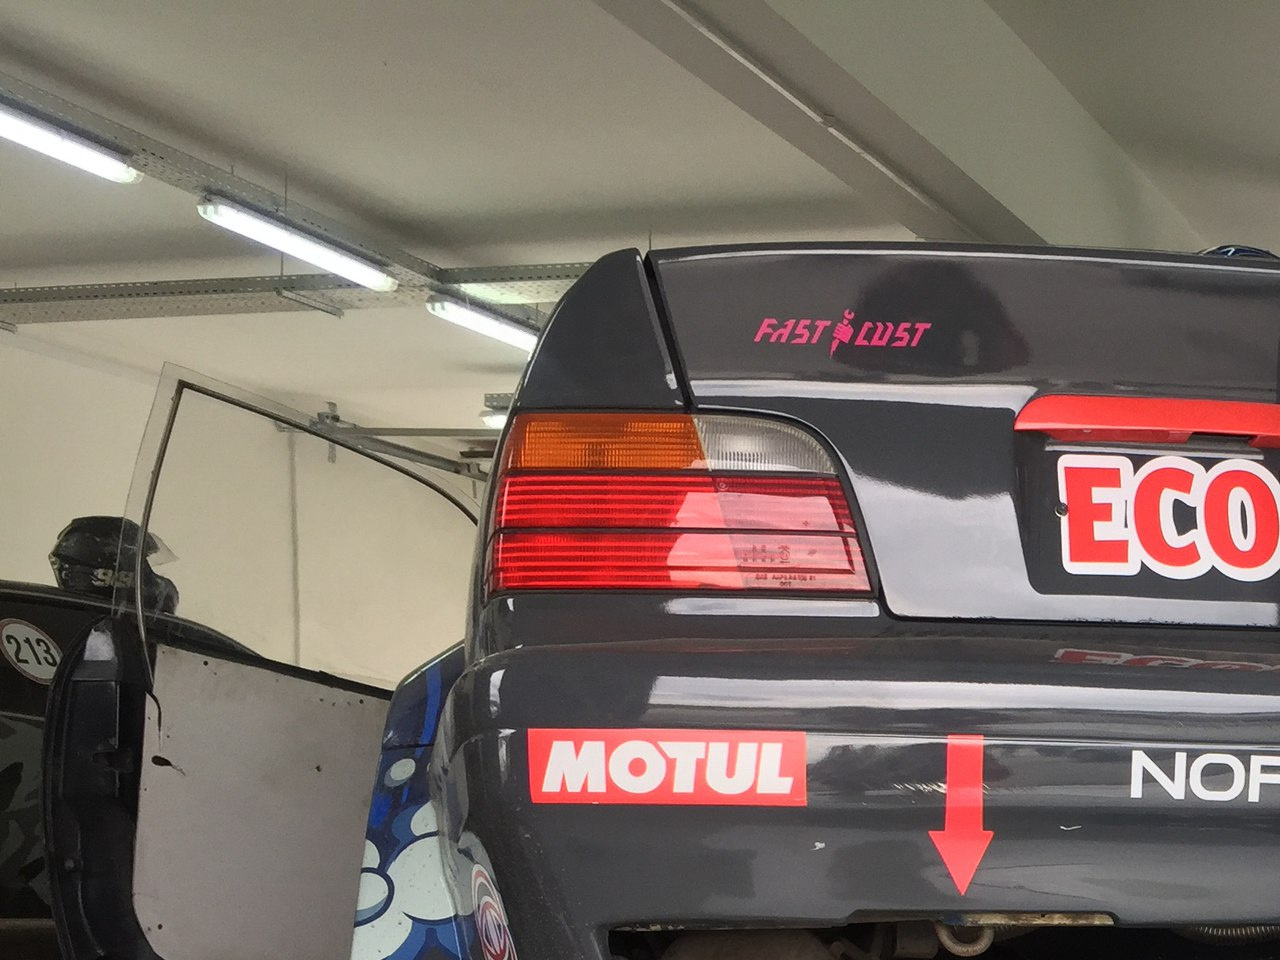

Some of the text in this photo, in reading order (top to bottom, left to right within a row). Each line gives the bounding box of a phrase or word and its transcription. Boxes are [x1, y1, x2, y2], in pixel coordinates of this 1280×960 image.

[753, 318, 932, 348] FAST LUST
[5, 634, 58, 667] 213
[541, 740, 794, 794] MOTUL
